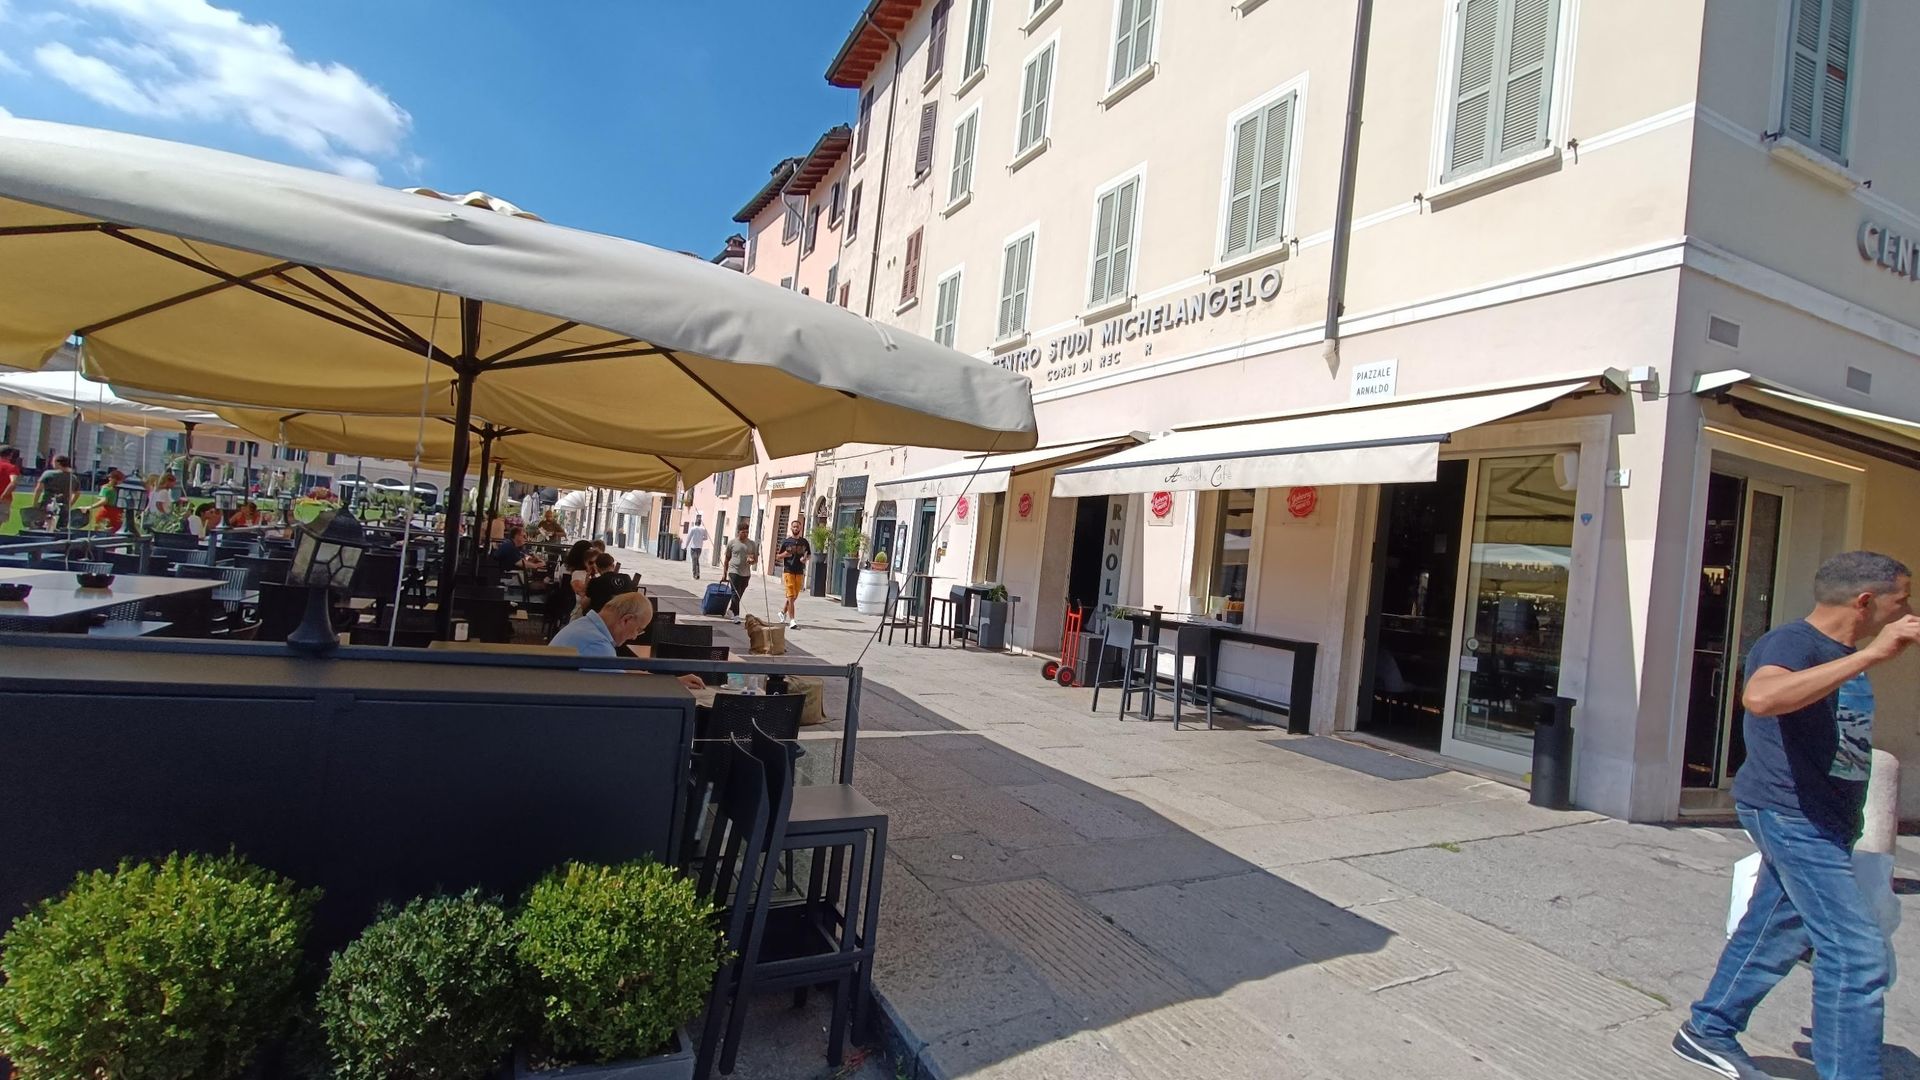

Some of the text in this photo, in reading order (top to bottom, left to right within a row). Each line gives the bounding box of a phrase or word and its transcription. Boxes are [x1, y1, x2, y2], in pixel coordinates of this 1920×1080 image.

[993, 268, 1283, 373] ENTRO STUDI MICHELANGELO
[1047, 362, 1076, 382] CORSI
[1082, 359, 1093, 373] DI
[1356, 367, 1391, 381] PIAZZALE
[1356, 383, 1389, 396] ARNALDO
